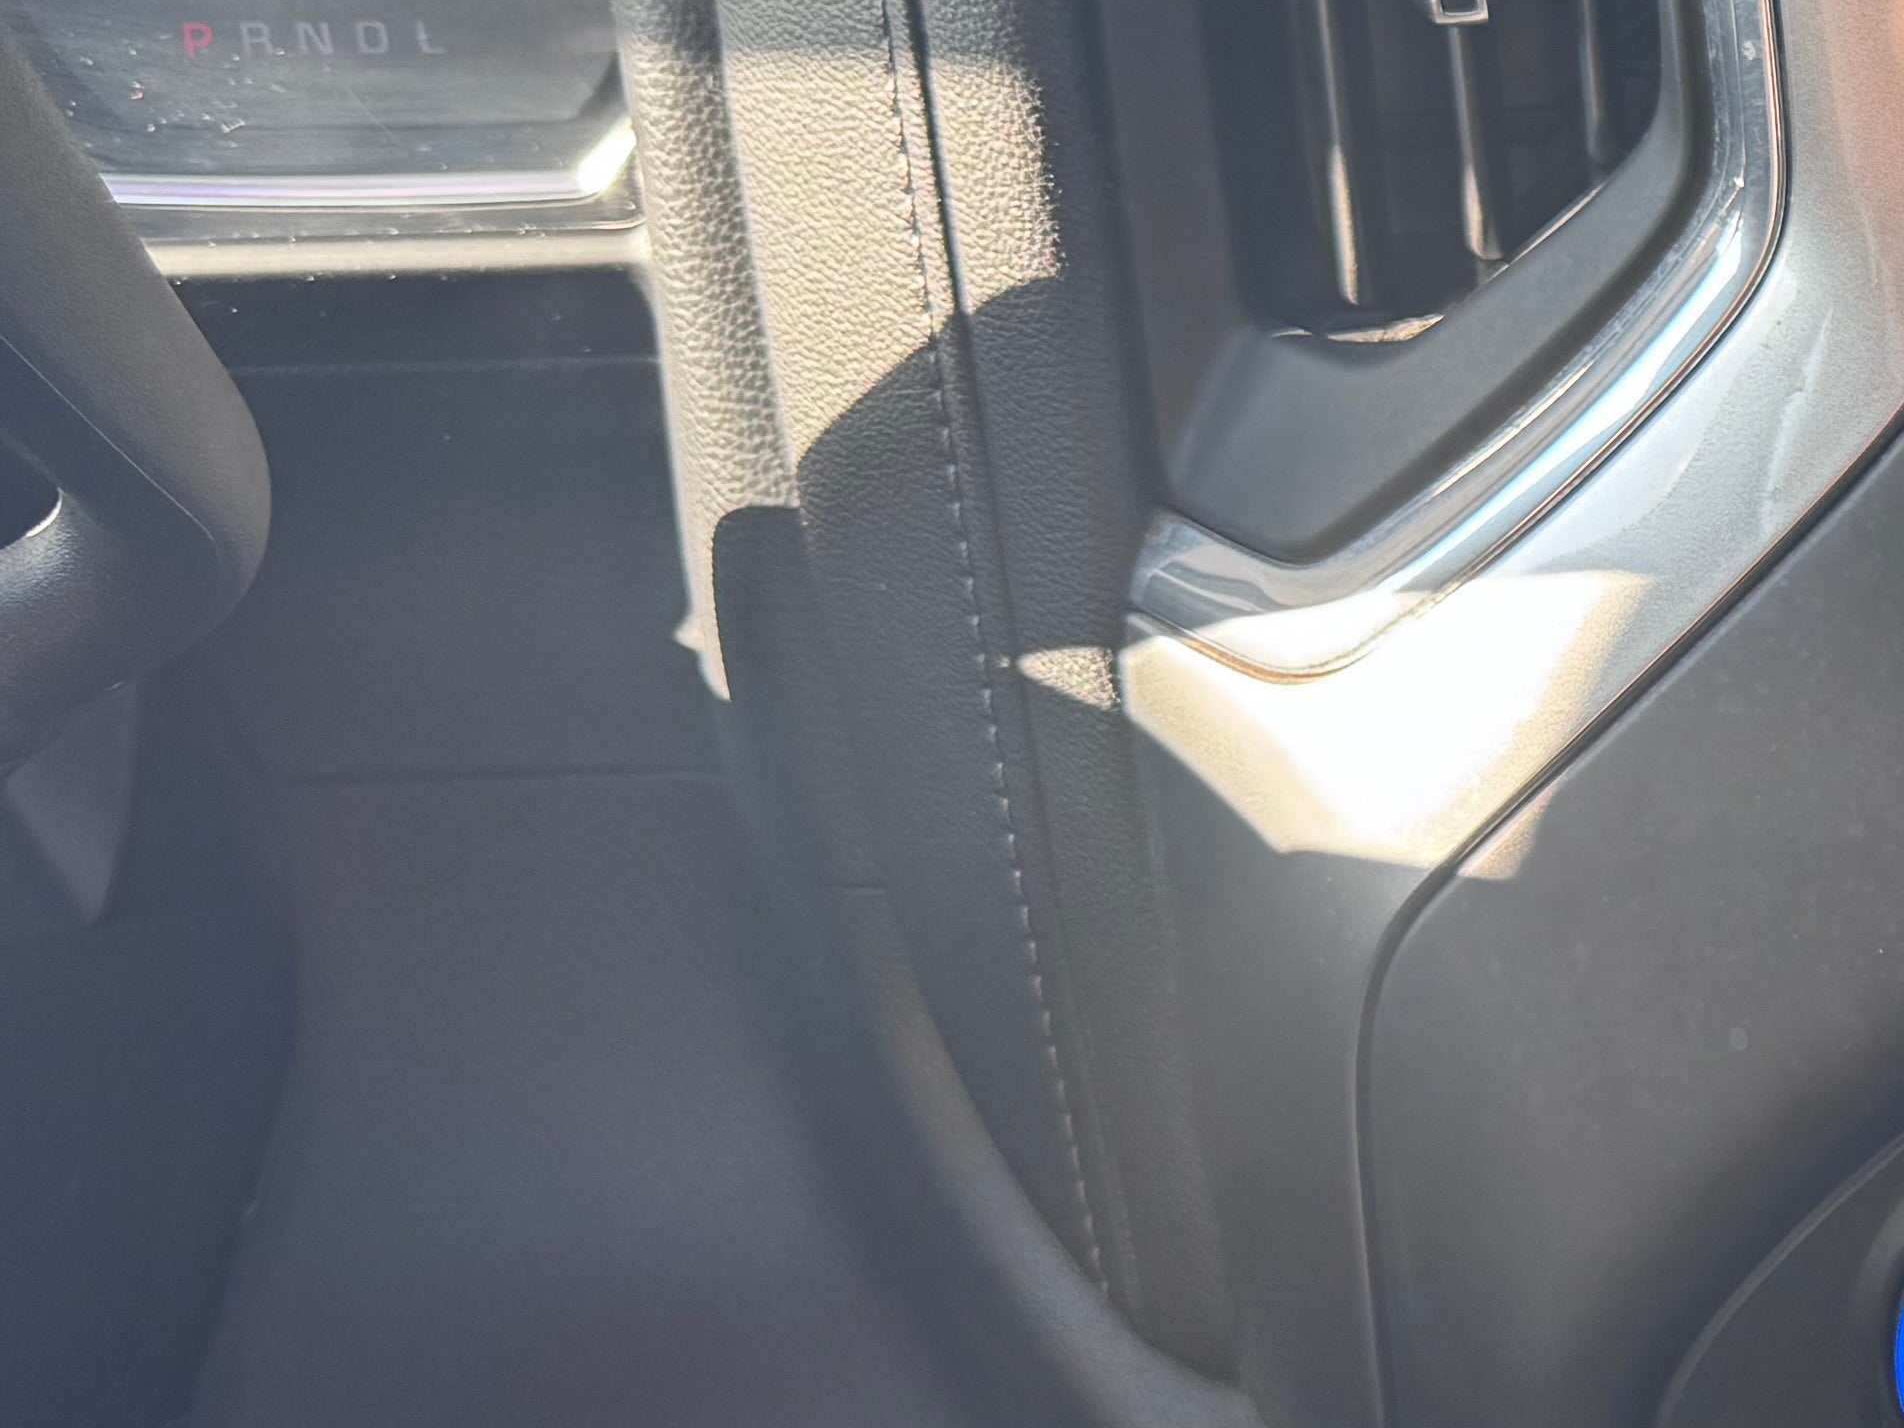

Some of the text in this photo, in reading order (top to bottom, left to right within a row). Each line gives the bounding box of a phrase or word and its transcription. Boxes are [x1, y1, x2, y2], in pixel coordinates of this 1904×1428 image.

[182, 23, 213, 58] P
[240, 22, 274, 56] R
[297, 21, 334, 56] N
[355, 21, 389, 55] D
